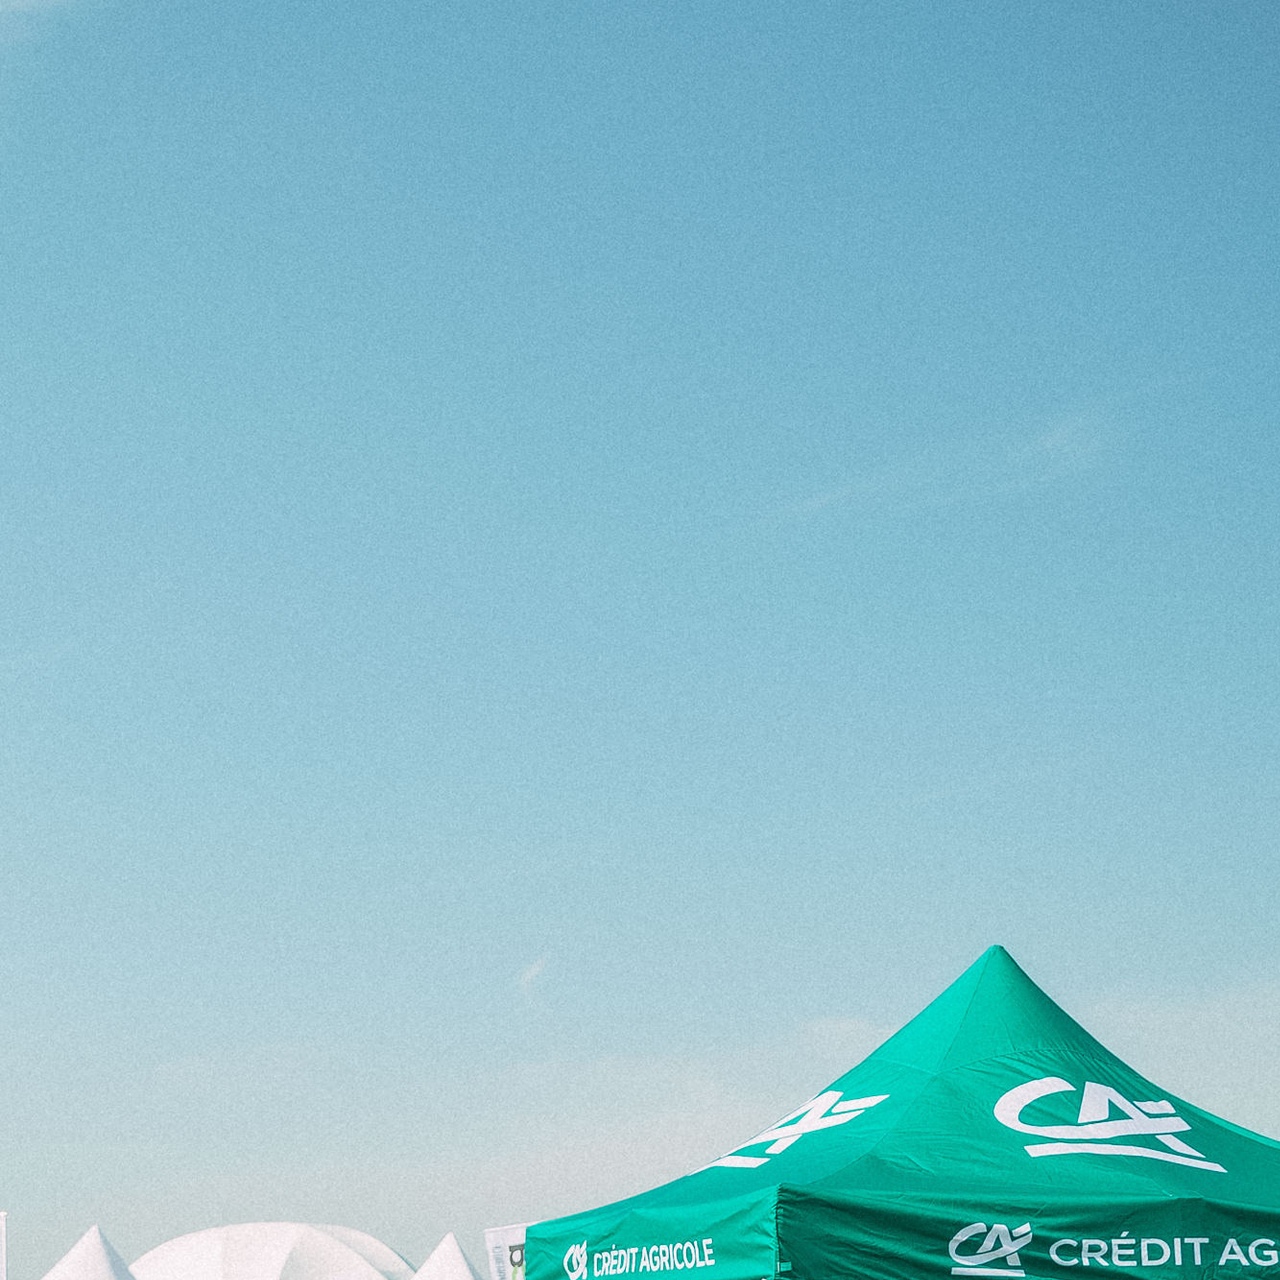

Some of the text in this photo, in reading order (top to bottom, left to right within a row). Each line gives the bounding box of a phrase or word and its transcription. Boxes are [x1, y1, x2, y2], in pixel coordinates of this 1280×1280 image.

[593, 1244, 639, 1277] CRÉDIT
[639, 1238, 715, 1273] AGRICOLE
[1049, 1231, 1210, 1267] CRÉDIT
